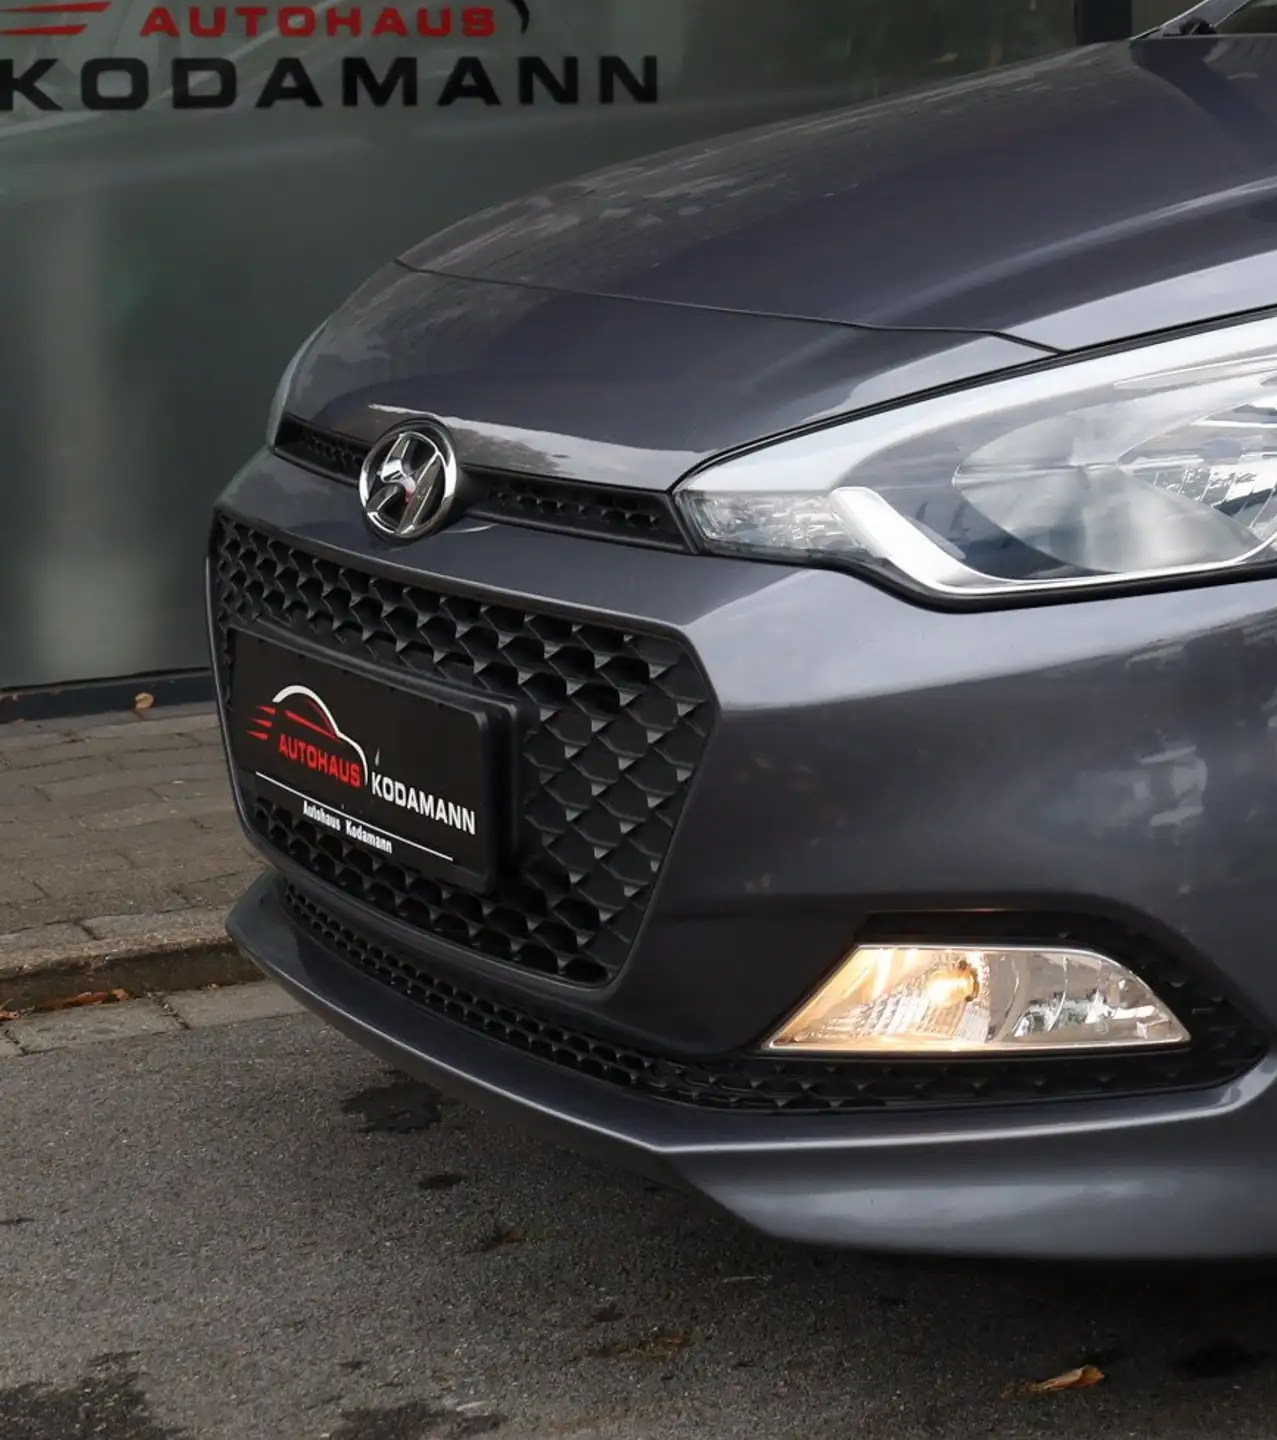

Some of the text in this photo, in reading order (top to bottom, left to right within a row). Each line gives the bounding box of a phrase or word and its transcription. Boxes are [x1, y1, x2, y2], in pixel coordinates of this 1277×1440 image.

[141, 6, 497, 37] AUTOHAUS
[0, 56, 658, 112] KODAMANN
[278, 733, 362, 789] AUTOHAUS
[370, 771, 476, 835] KODAMANN
[345, 819, 393, 854] Kodamann
